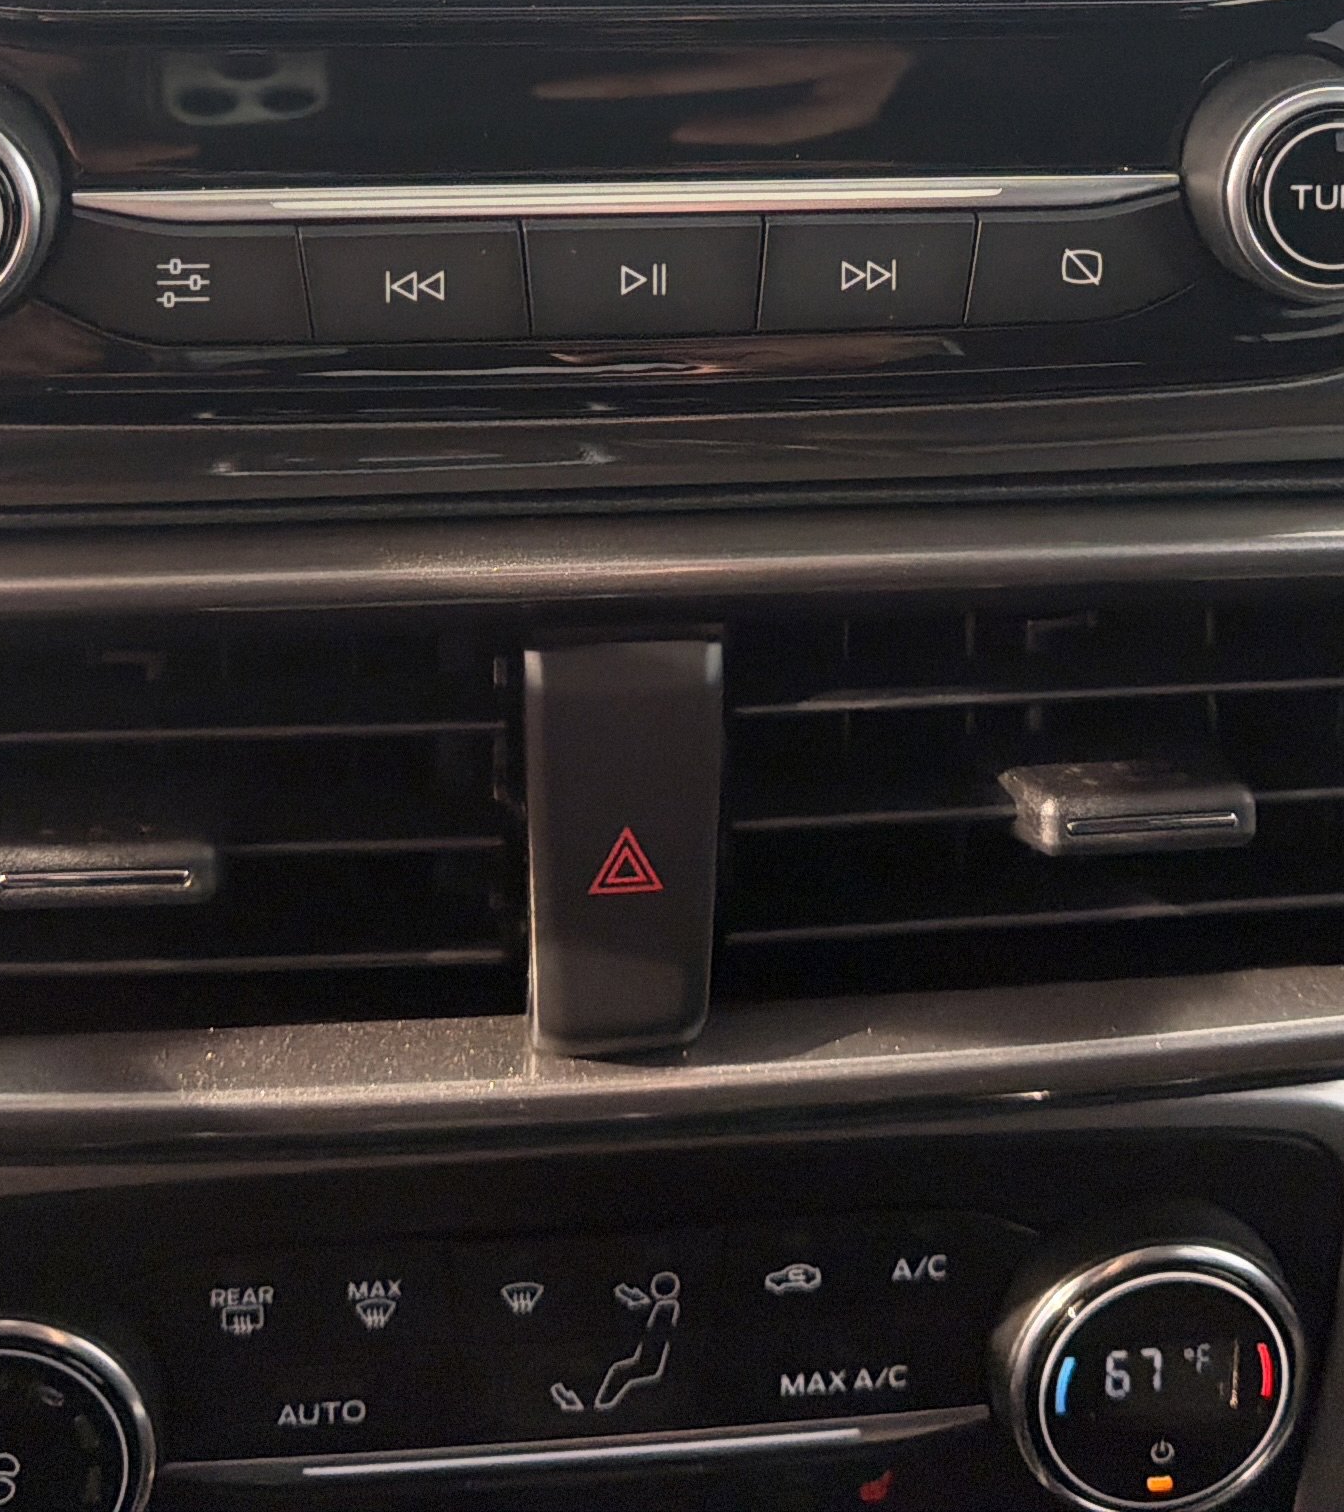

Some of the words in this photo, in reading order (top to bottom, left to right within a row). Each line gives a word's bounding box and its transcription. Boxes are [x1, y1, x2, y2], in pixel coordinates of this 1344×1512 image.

[891, 1254, 948, 1282] A/C
[209, 1286, 275, 1307] REAR
[347, 1279, 402, 1300] MAX
[779, 1370, 846, 1397] MAX
[852, 1363, 908, 1391] A/C
[1105, 1347, 1164, 1399] 67
[276, 1399, 367, 1427] AUTO
